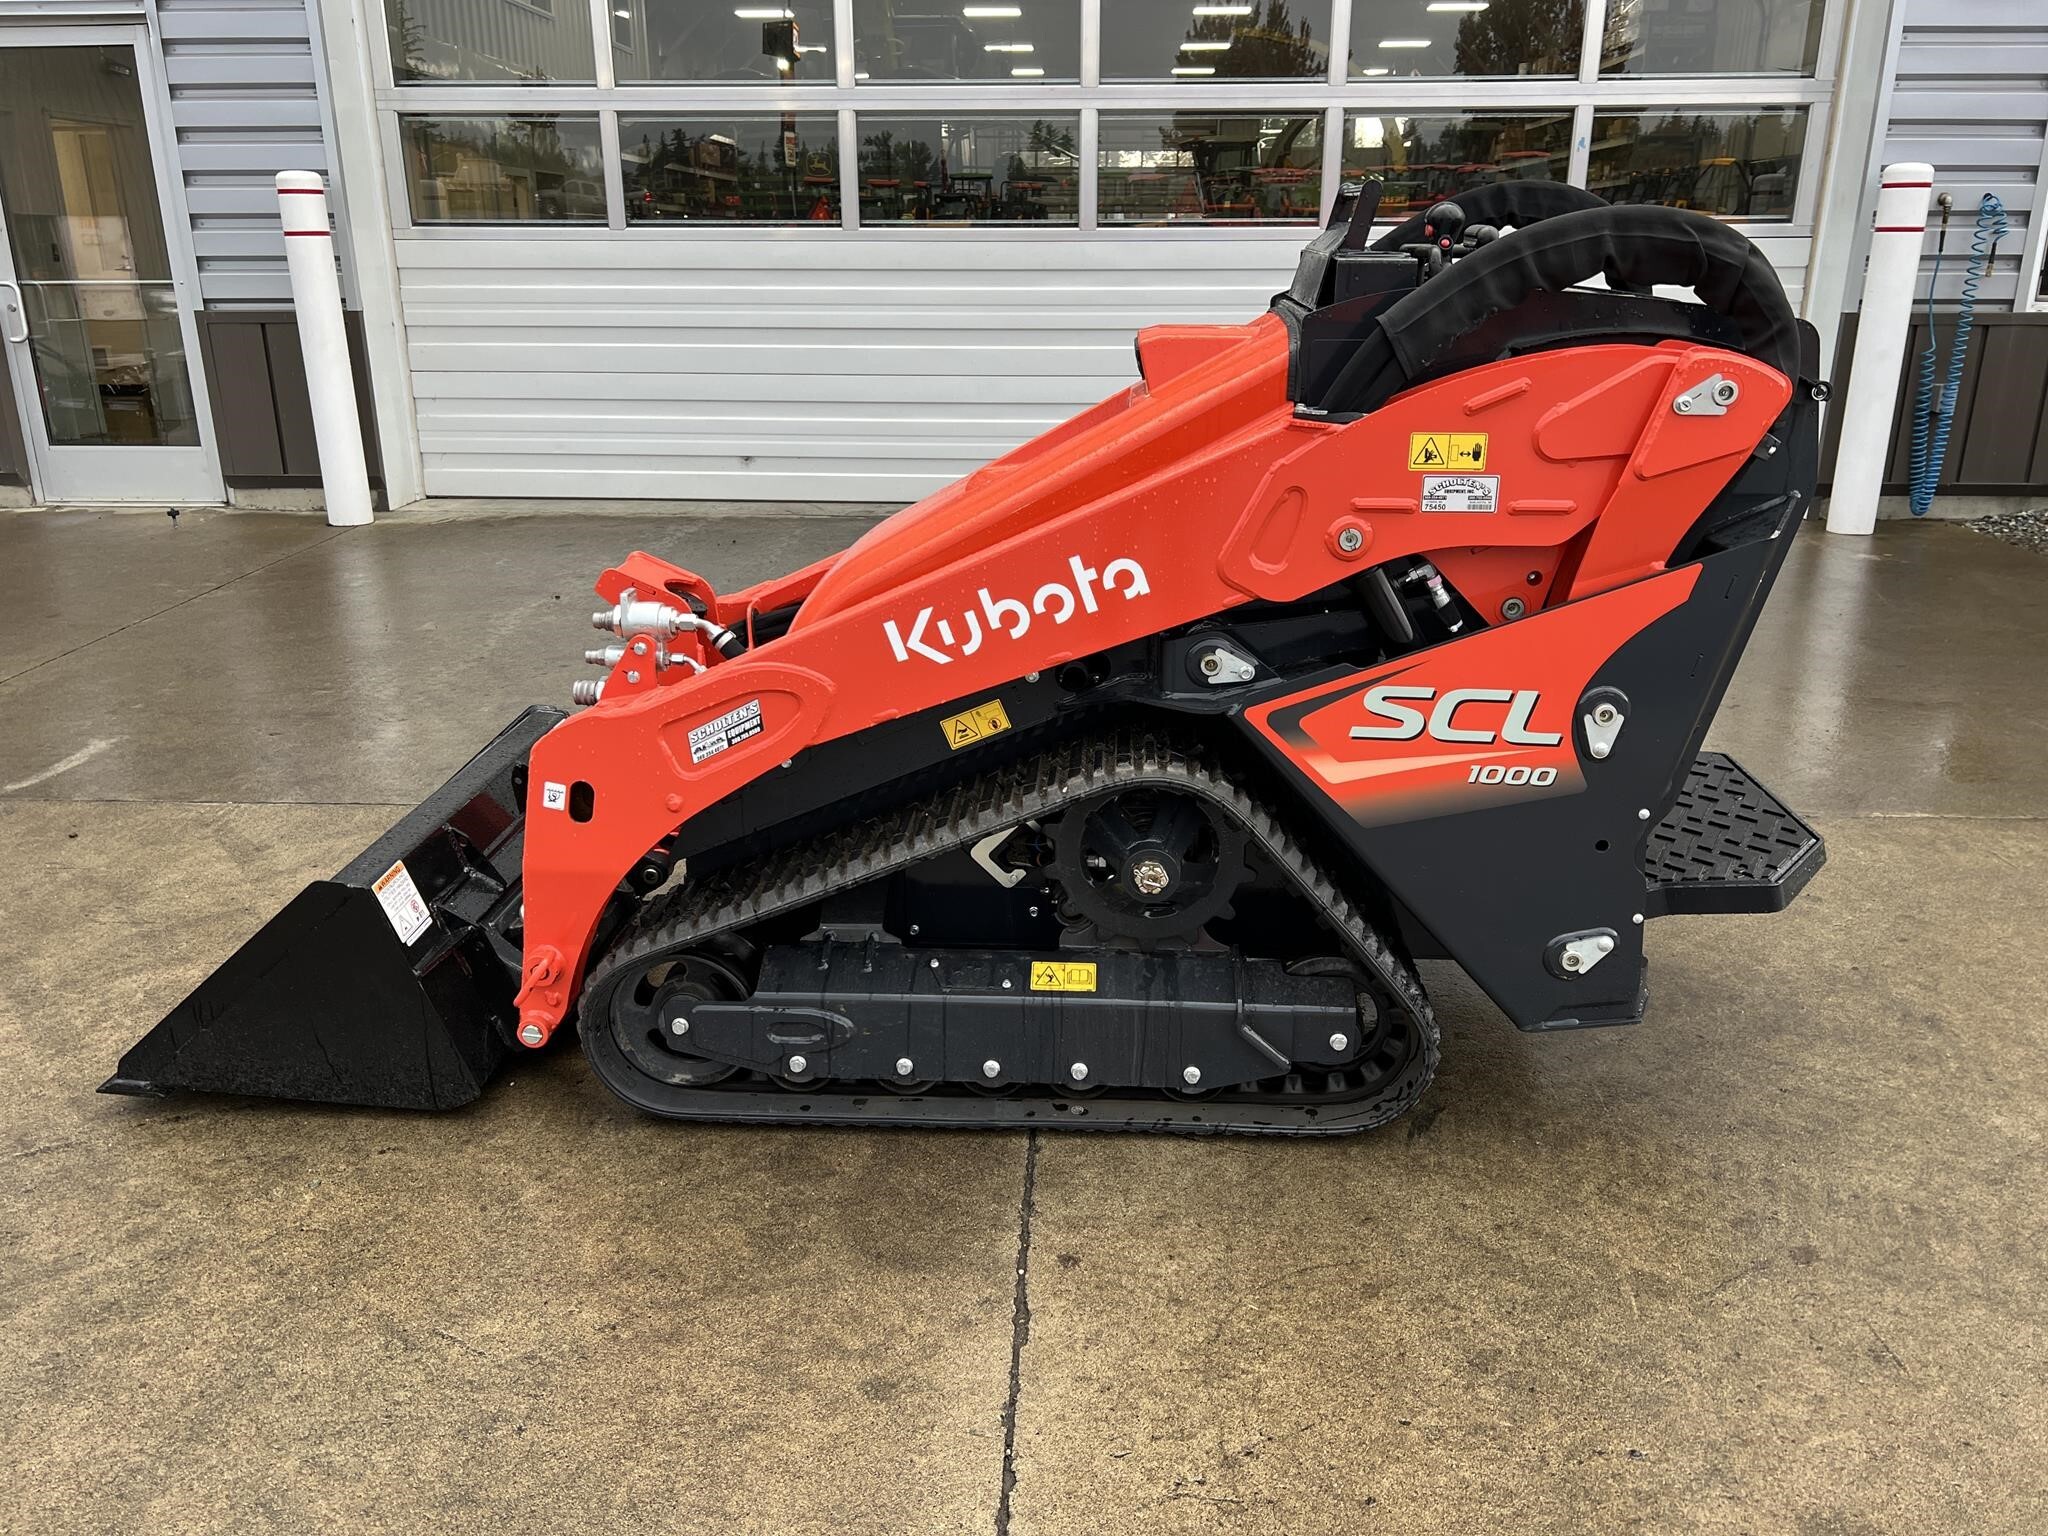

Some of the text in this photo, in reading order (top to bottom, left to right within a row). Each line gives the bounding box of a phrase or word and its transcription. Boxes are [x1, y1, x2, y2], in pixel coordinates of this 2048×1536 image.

[1428, 478, 1491, 496] SCHOLTEN'S
[883, 555, 1150, 664] Kubota
[690, 702, 759, 744] SCHOLTEN'S
[727, 716, 761, 738] EQUIPMENT
[1349, 686, 1563, 747] SCL
[1467, 765, 1559, 787] 1000
